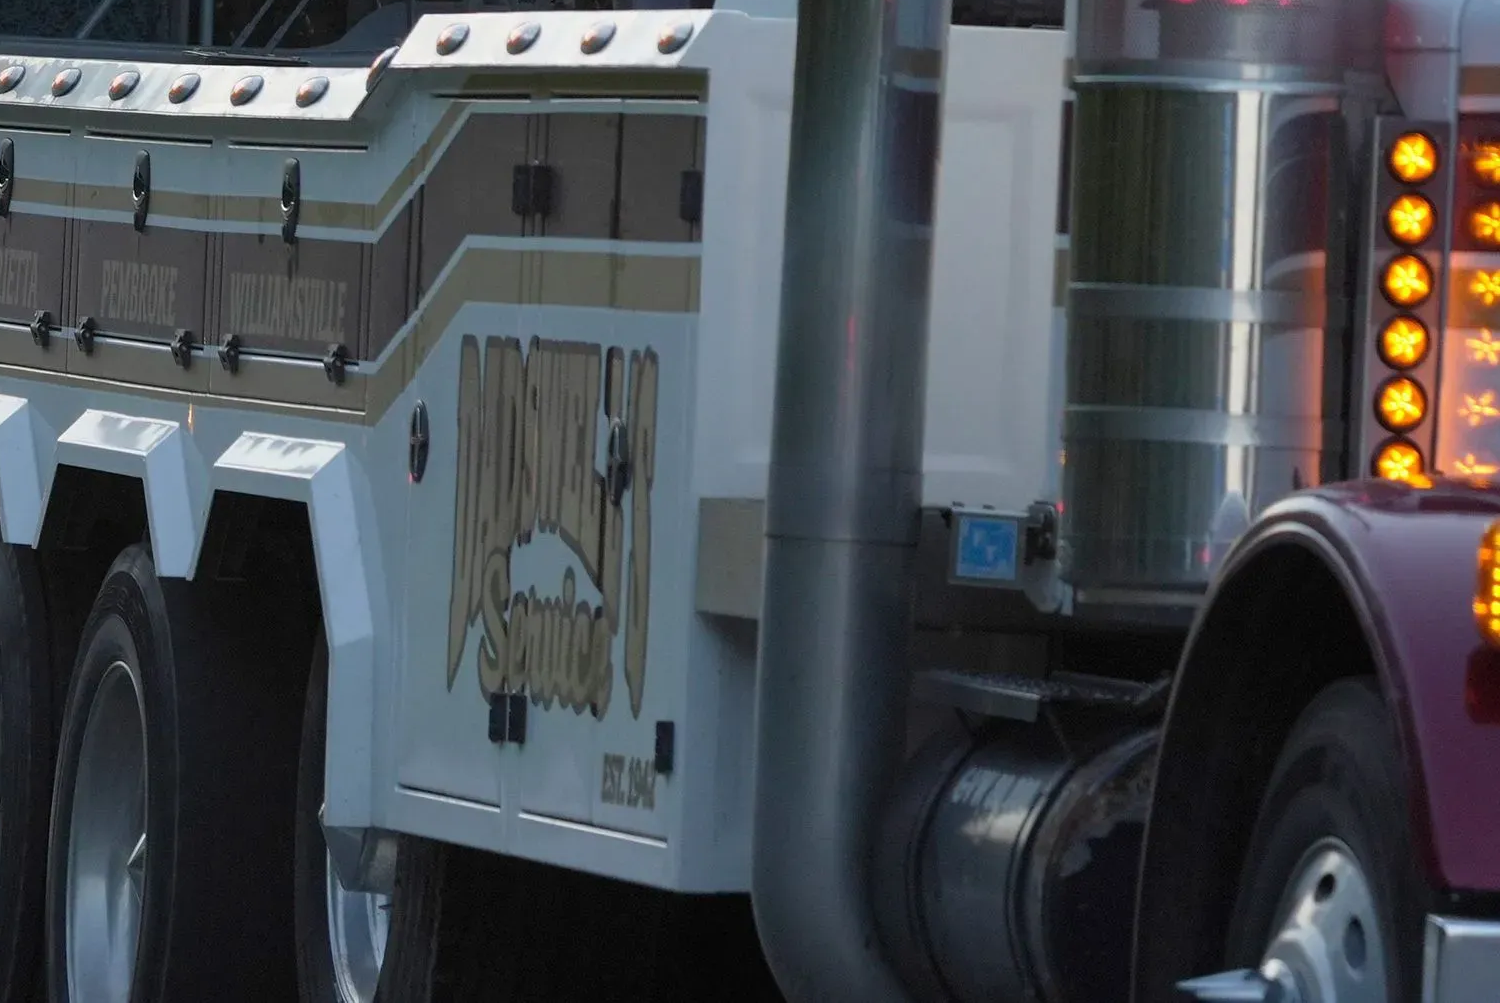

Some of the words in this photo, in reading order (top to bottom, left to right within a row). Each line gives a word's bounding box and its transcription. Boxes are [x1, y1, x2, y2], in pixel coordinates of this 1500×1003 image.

[101, 260, 179, 326] PEMBROKE
[230, 272, 348, 343] WILLIAMSVILLE
[478, 547, 613, 721] Service
